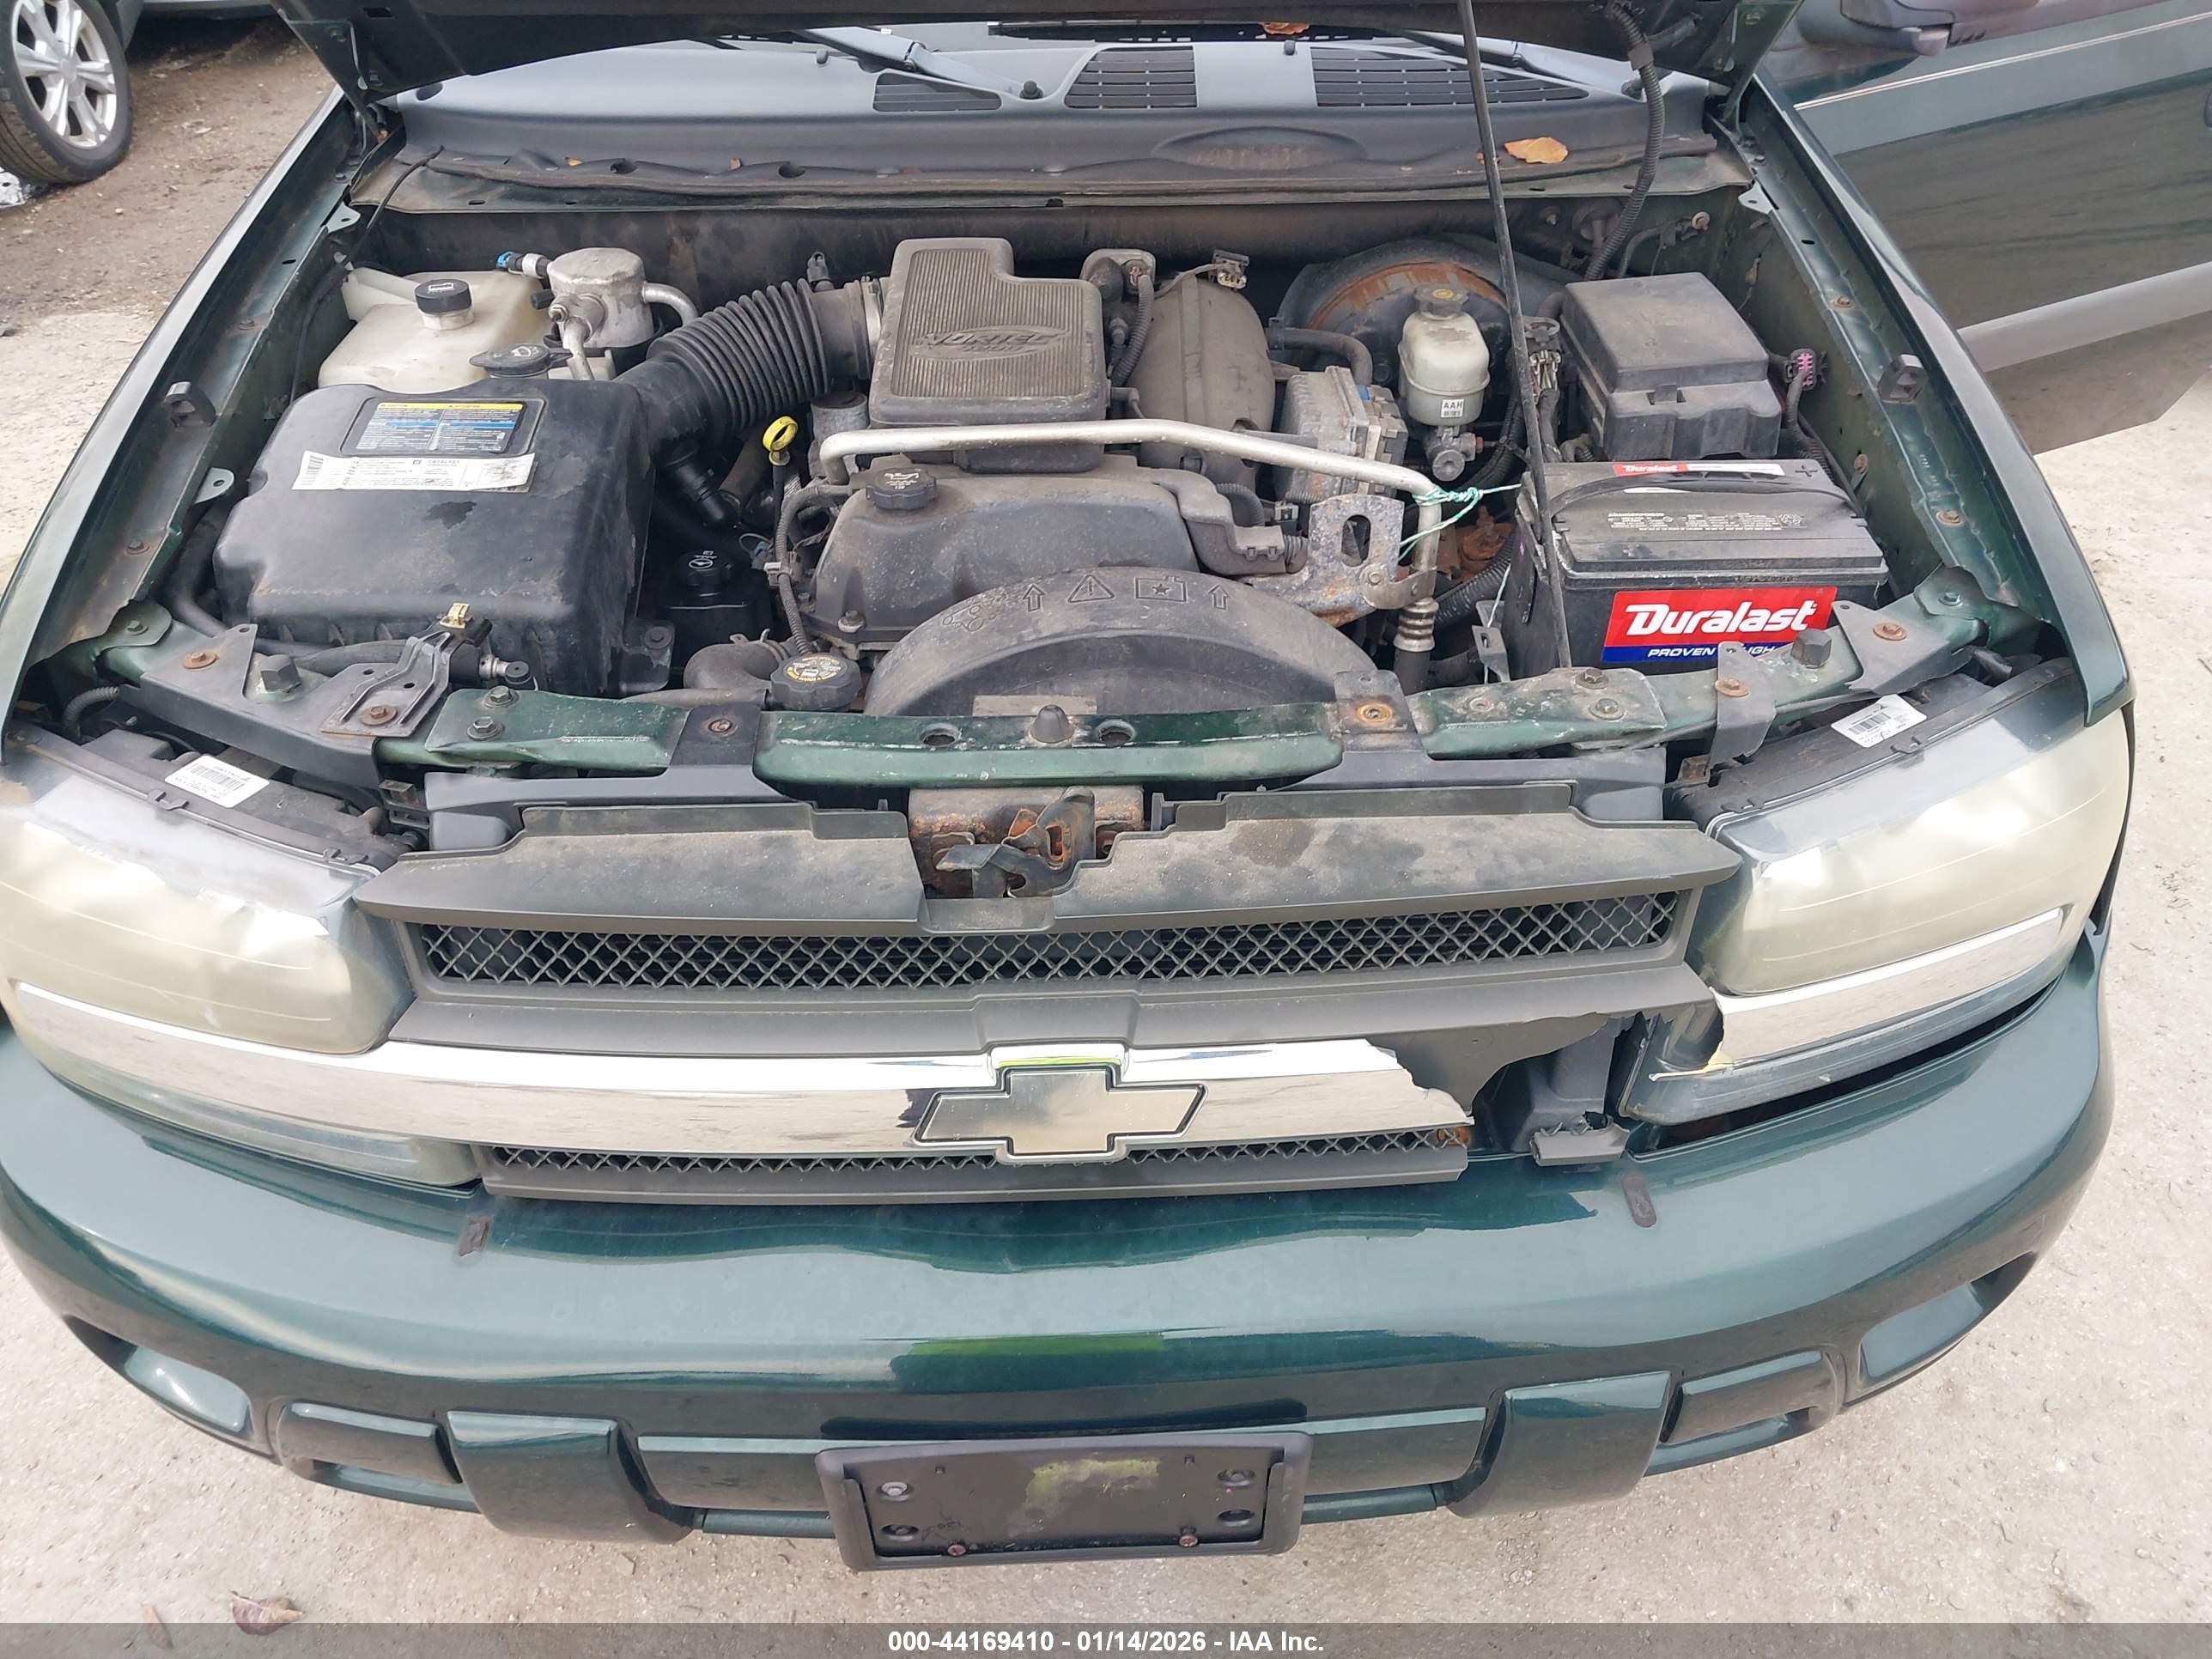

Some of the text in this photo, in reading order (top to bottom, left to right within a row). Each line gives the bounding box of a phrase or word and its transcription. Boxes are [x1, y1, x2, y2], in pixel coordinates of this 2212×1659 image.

[1621, 464, 1679, 473] Duralast
[1626, 600, 1816, 635] Duralast
[1647, 647, 1717, 658] PROVEN
